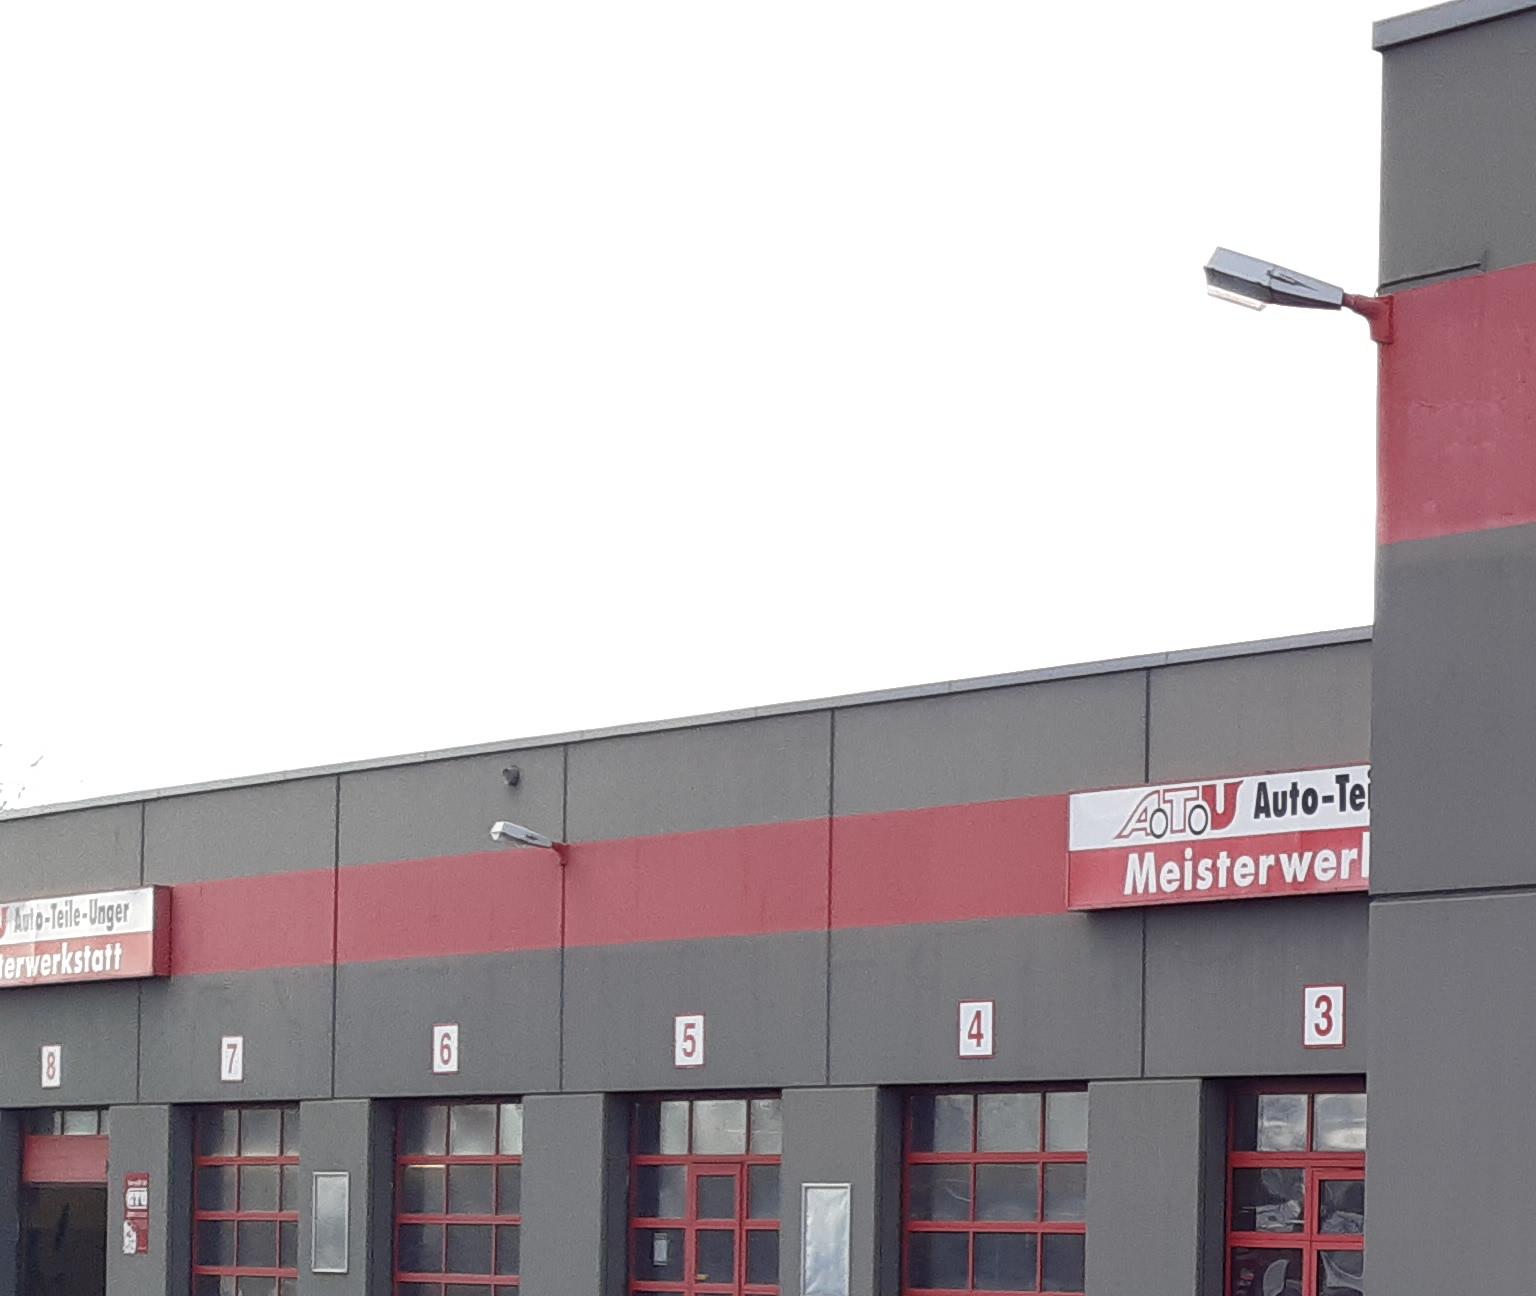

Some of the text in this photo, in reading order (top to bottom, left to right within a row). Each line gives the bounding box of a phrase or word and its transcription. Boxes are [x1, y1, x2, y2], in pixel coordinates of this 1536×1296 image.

[14, 898, 130, 933] Auto-Teile-Unger
[967, 1009, 984, 1048] 4
[1314, 994, 1333, 1037] 3
[226, 1043, 238, 1074] 7
[439, 1032, 452, 1066] 6
[682, 1023, 696, 1060] 5
[45, 1051, 56, 1079] 8
